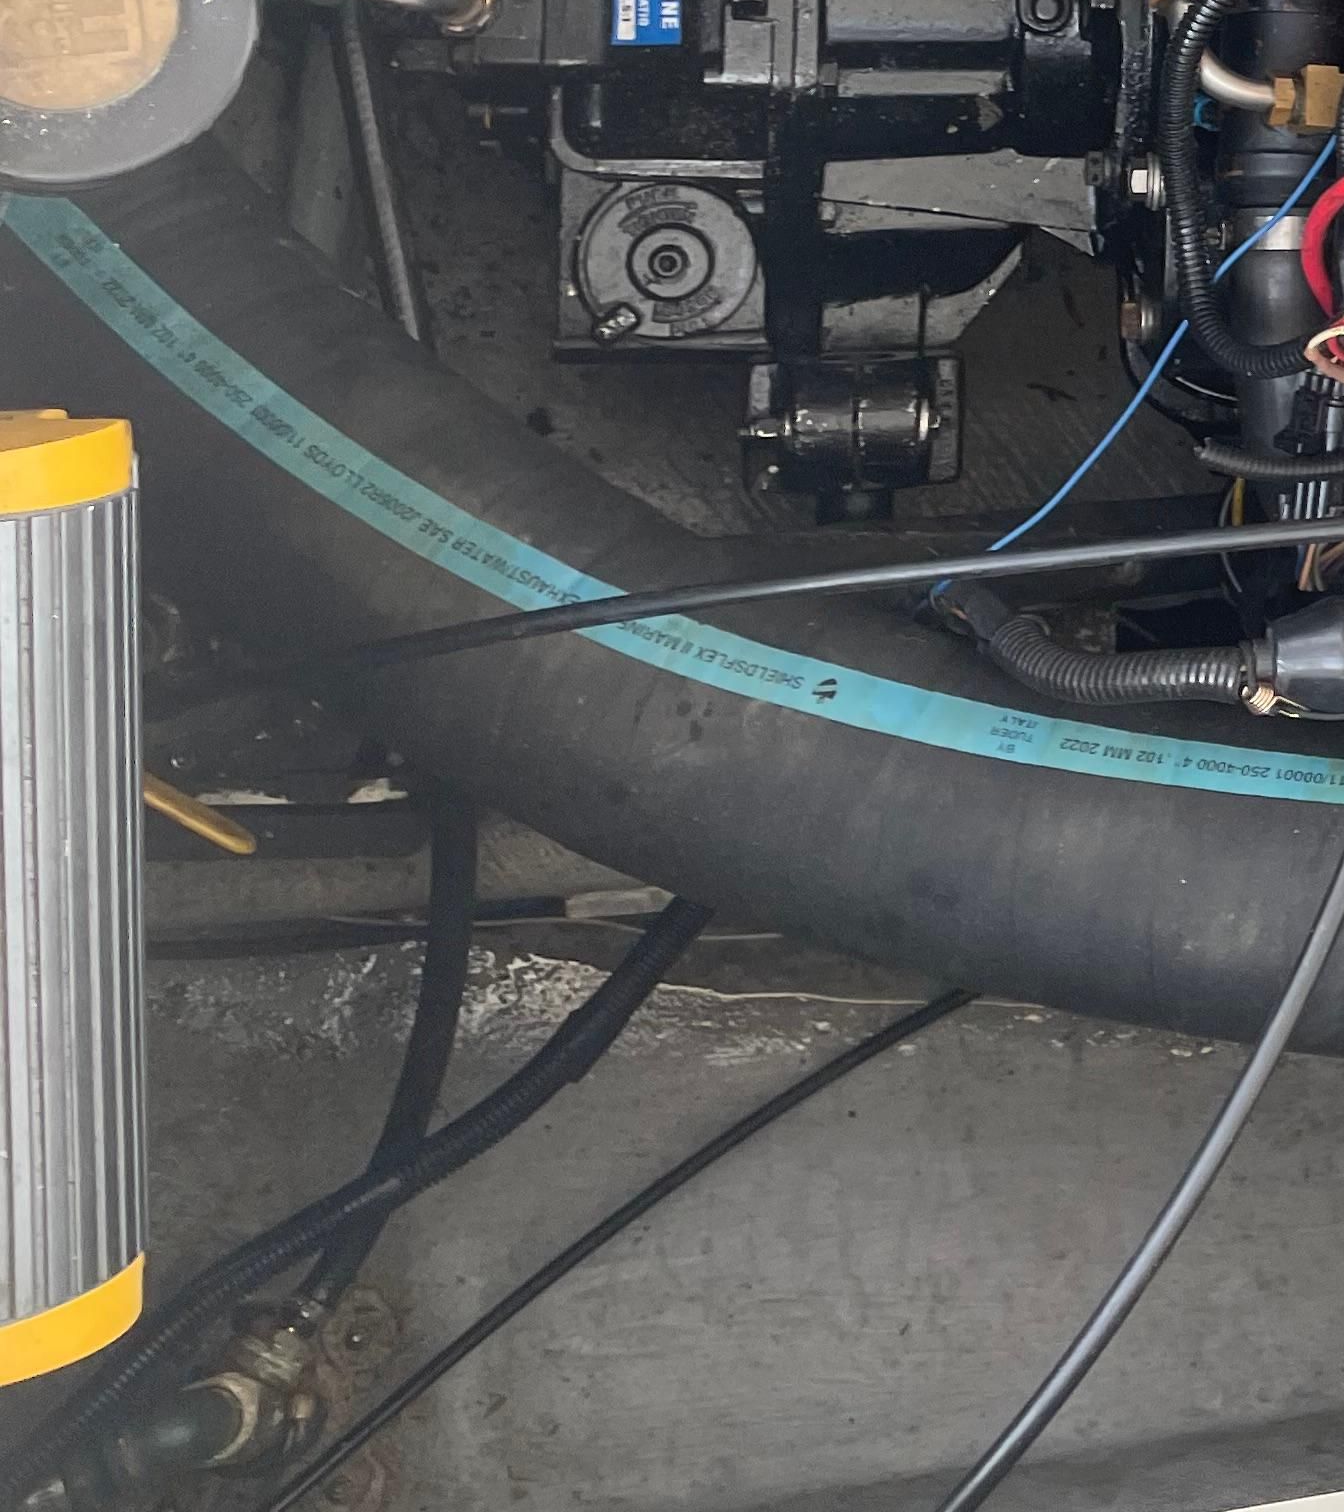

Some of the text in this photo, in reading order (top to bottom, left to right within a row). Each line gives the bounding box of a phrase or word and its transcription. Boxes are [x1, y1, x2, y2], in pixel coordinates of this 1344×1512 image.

[417, 518, 454, 545] SAE
[691, 645, 805, 690] SHIELDSFLEX
[989, 725, 1034, 743] TUDER
[1058, 737, 1101, 756] 2022
[1101, 744, 1133, 761] MM
[1196, 759, 1270, 779] 250-4000
